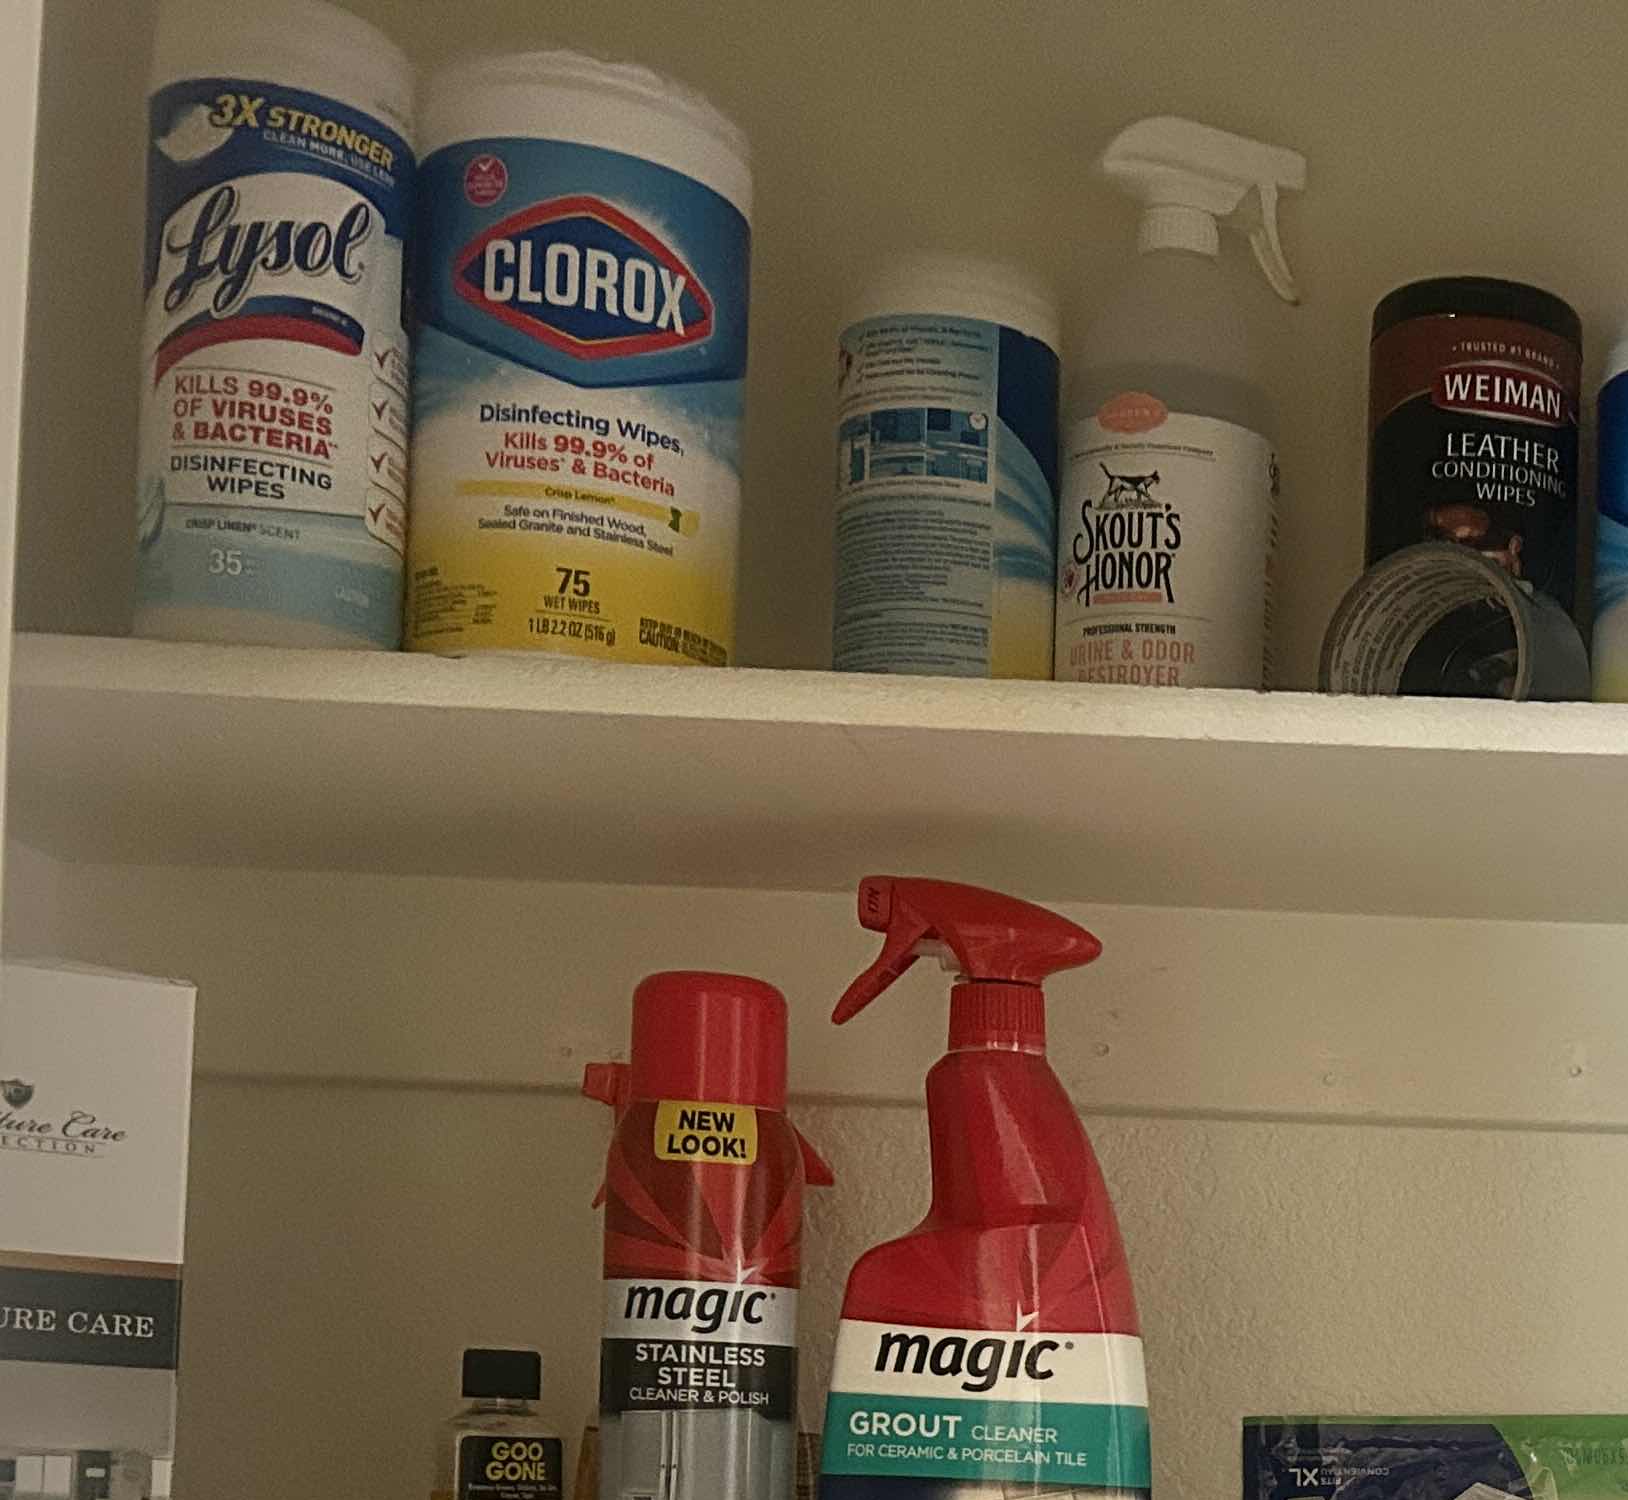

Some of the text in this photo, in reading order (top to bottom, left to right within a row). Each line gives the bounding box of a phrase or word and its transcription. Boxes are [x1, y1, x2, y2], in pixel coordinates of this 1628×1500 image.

[208, 93, 395, 170] 3X STRONGER
[164, 184, 371, 314] Lysol
[484, 239, 686, 337] CLOROX
[174, 375, 333, 415] KILLS 99.9%
[1444, 373, 1561, 418] WEIMAN
[173, 398, 332, 436] OF VIRUSES
[479, 403, 610, 436] Disinfecting
[172, 422, 185, 442] &
[503, 431, 655, 470] Kills 99.9% of
[1447, 433, 1559, 473] LEATHER
[170, 455, 332, 490] DISINFECTING
[571, 458, 675, 497] & Bacteria
[1432, 461, 1566, 498] CONDITIONING
[207, 475, 286, 500] WIPES
[1476, 482, 1536, 507] WIPES
[478, 518, 590, 539] Sealed Granite and
[503, 504, 604, 528] Safe on Finished
[207, 549, 242, 576] 35
[556, 567, 590, 597] 75
[1077, 551, 1175, 607] HONOR
[543, 595, 600, 615] WET WIPES
[1070, 639, 1195, 666] URINE & ODOR
[62, 1110, 129, 1142] Care
[678, 1109, 735, 1133] NEW
[666, 1134, 747, 1159] LOOK!
[624, 1284, 768, 1335] magic
[68, 1311, 155, 1338] CARE
[635, 1343, 766, 1367] STAINLESS
[875, 1331, 1059, 1393] magic
[657, 1367, 736, 1388] STEEL
[629, 1387, 769, 1406] CLEANER & POLISH
[848, 1411, 1057, 1444] GROUT CLEANER
[492, 1441, 543, 1462] GOO
[847, 1443, 1088, 1467] FOR CERAMIC & PORCELAIN TILE
[485, 1461, 546, 1481] GONE
[1289, 1468, 1319, 1487] XL
